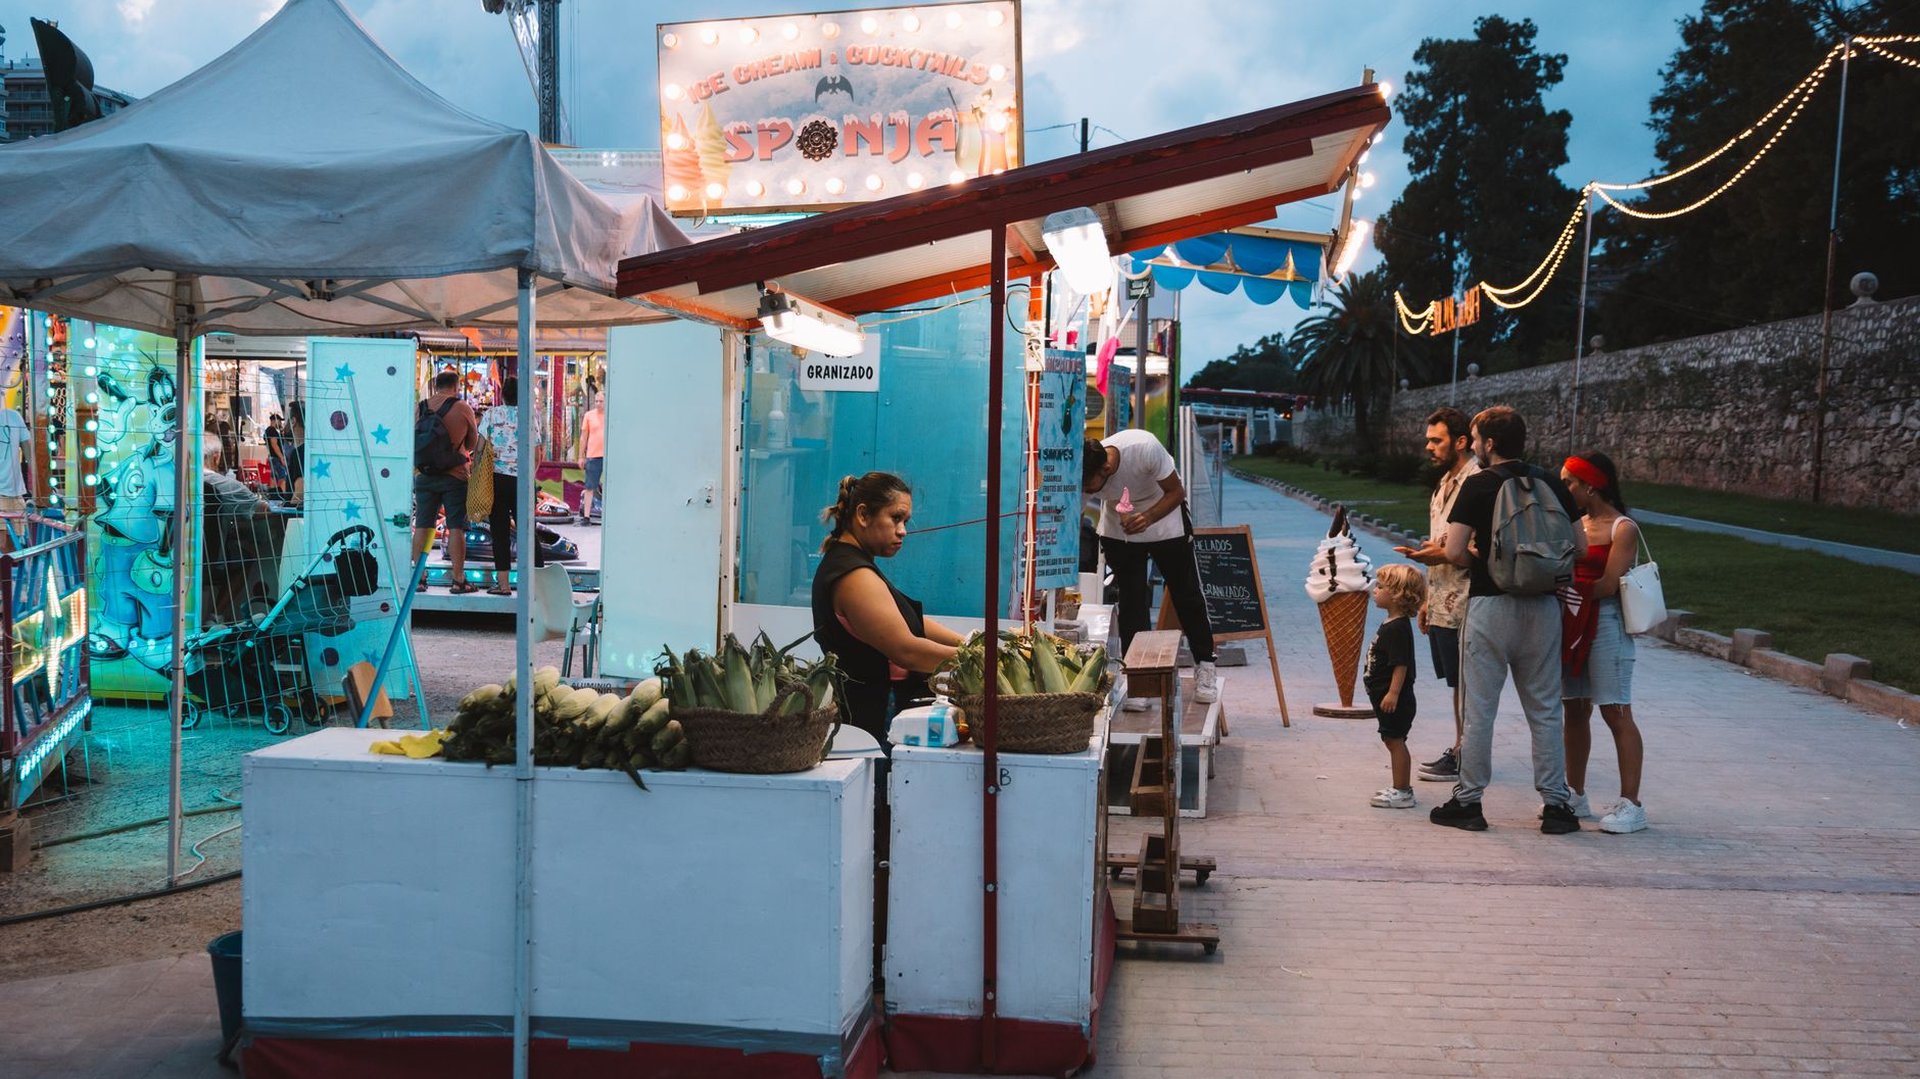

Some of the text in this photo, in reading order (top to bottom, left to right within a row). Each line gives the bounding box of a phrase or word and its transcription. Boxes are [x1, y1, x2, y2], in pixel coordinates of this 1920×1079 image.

[687, 70, 730, 104] ICE
[732, 48, 822, 85] CREAM
[846, 44, 989, 85] COCKTAILS
[807, 365, 873, 380] GRANIZADO
[1194, 539, 1232, 551] HELADOS
[1000, 768, 1011, 786] B
